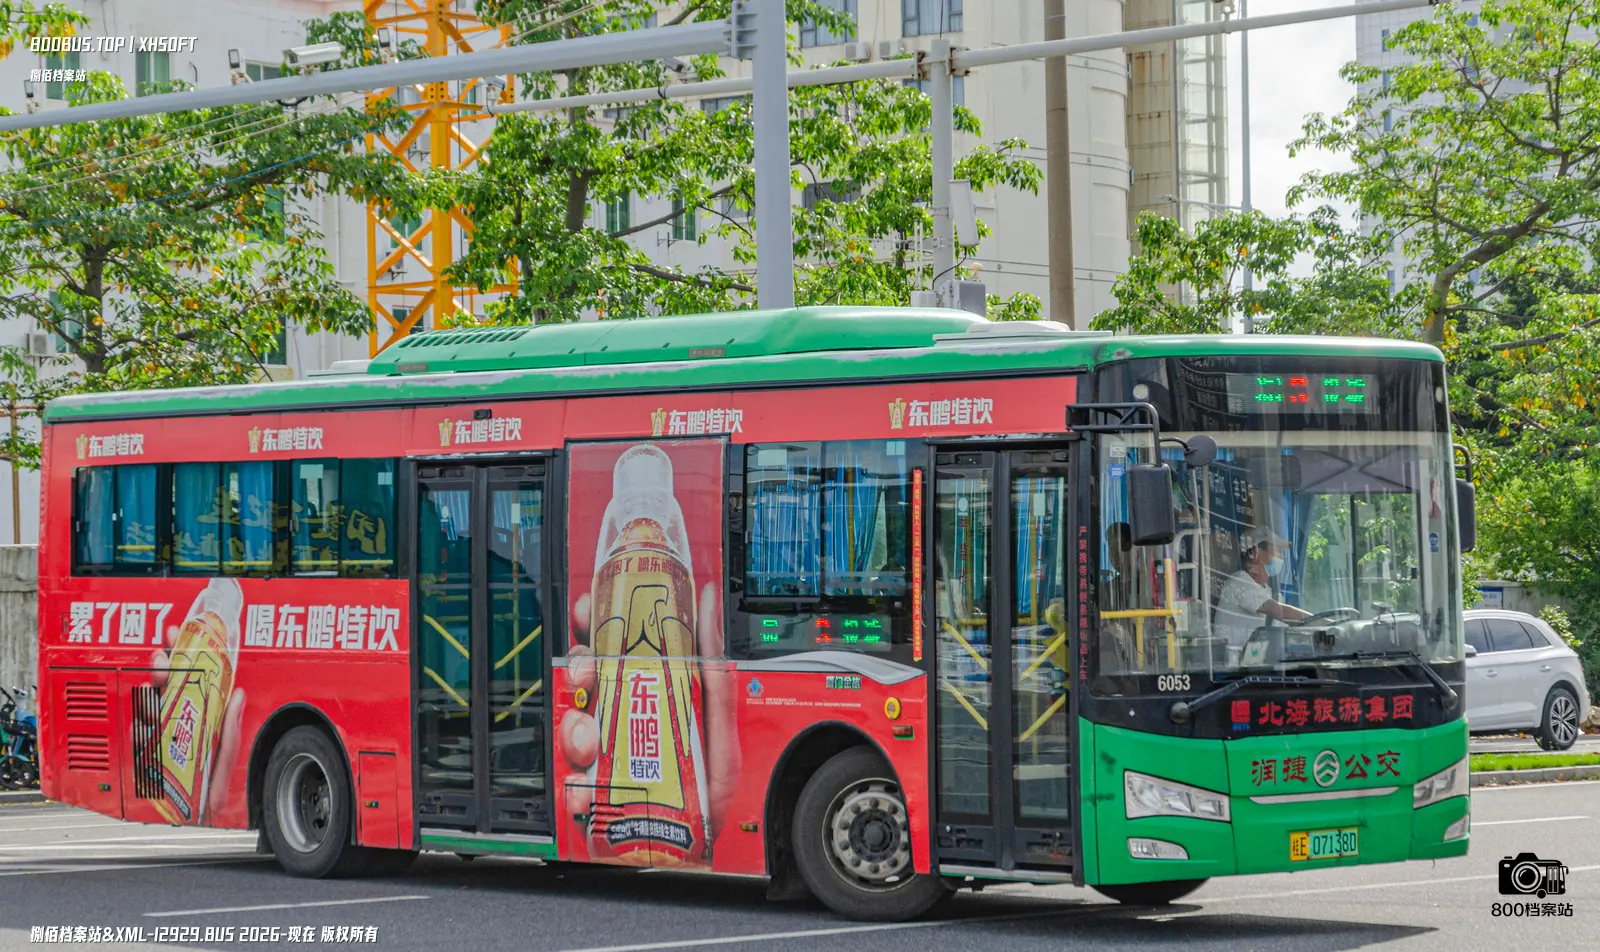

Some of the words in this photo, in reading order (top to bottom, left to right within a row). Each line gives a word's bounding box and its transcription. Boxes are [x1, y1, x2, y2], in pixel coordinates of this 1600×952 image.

[668, 408, 744, 434] 东鹏特饮
[909, 397, 993, 427] 东鹏特饮
[262, 427, 323, 451] 东鹏特饮
[455, 417, 522, 444] 东鹏特饮
[88, 433, 144, 457] 东鹏特饮
[68, 602, 174, 645] 累了困了
[244, 604, 400, 651] 喝东鹏特饮
[1157, 674, 1191, 692] 6053
[630, 673, 660, 757] 东鹏
[1259, 694, 1414, 726] 北海旅游集团
[630, 759, 661, 780] 特饮
[1251, 755, 1309, 786] 润捷
[1345, 749, 1401, 780] 公交
[1292, 836, 1308, 858] 桂E
